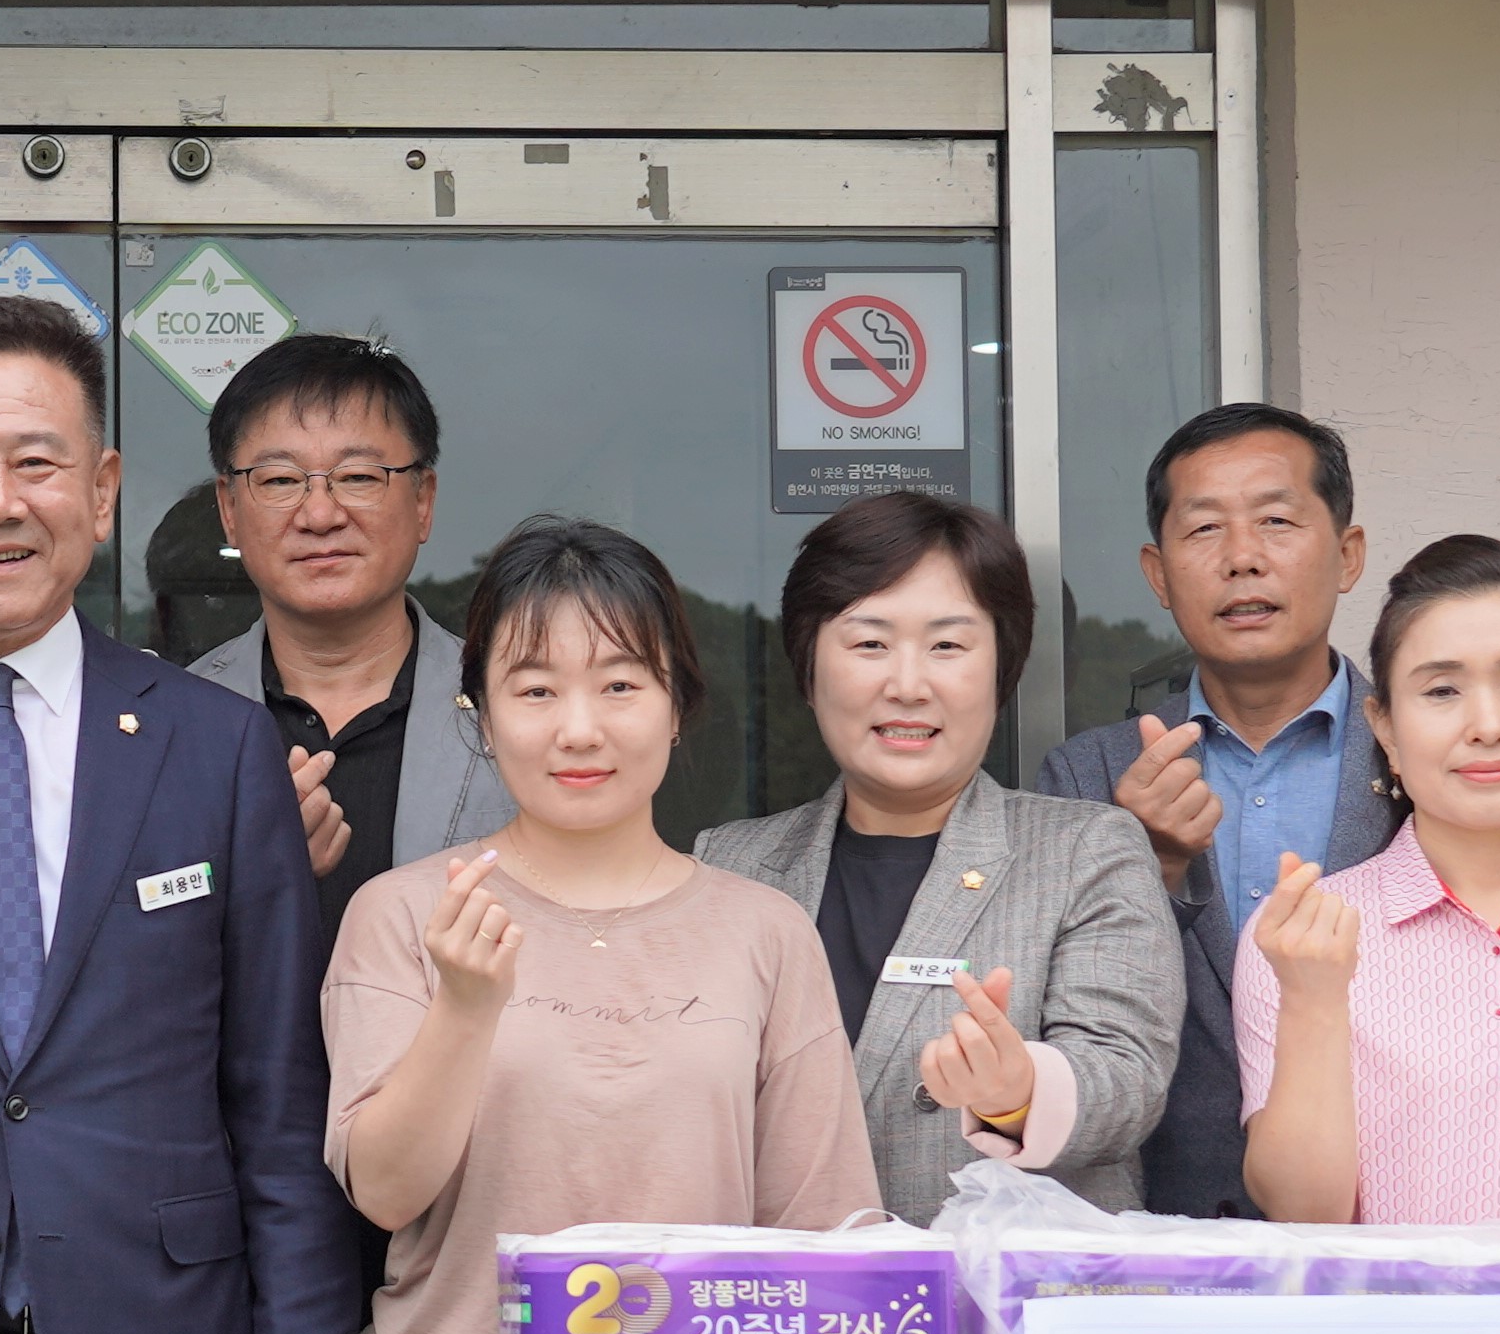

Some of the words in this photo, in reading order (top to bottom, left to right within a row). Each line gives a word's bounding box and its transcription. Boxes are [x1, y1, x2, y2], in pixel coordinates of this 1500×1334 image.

[156, 311, 200, 336] ECO
[205, 311, 265, 336] ZONE
[822, 426, 844, 440] NO
[850, 425, 921, 441] SMOKING!
[810, 467, 821, 479] 이
[824, 467, 844, 479] 곳은
[847, 464, 933, 479] 금연구역입니다.
[162, 873, 202, 895] 최용만
[689, 1280, 807, 1307] 잘풀리는집
